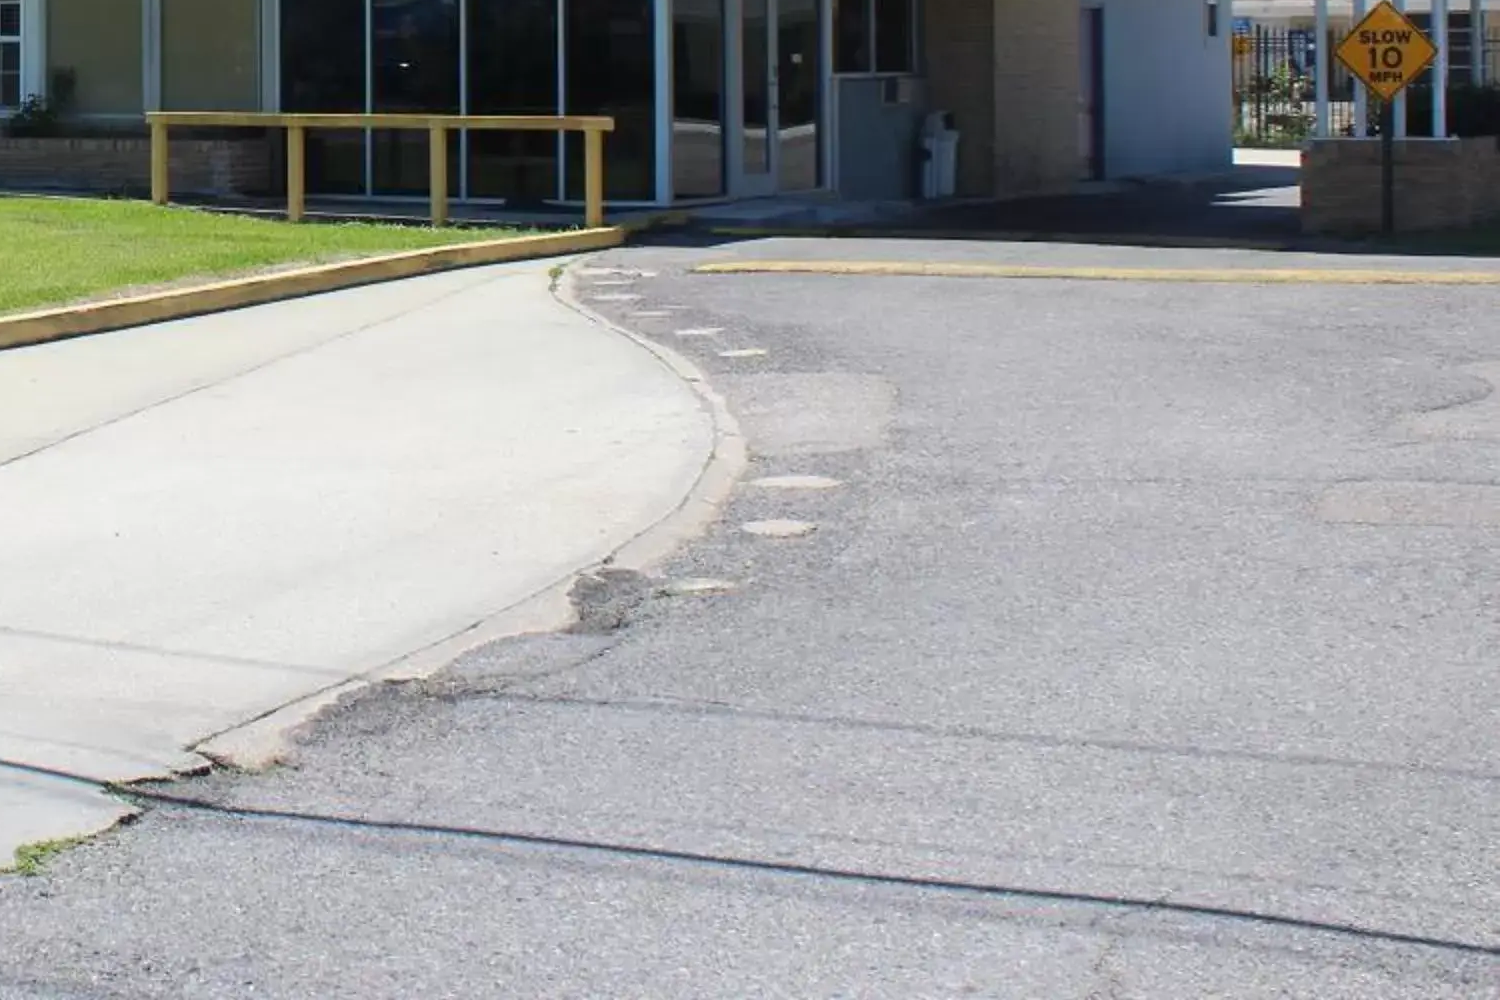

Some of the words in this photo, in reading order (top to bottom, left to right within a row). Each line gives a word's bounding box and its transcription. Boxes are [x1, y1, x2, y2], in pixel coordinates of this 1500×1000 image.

[1359, 30, 1412, 44] SLOW
[1368, 46, 1402, 69] 10
[1369, 71, 1403, 83] MPH
